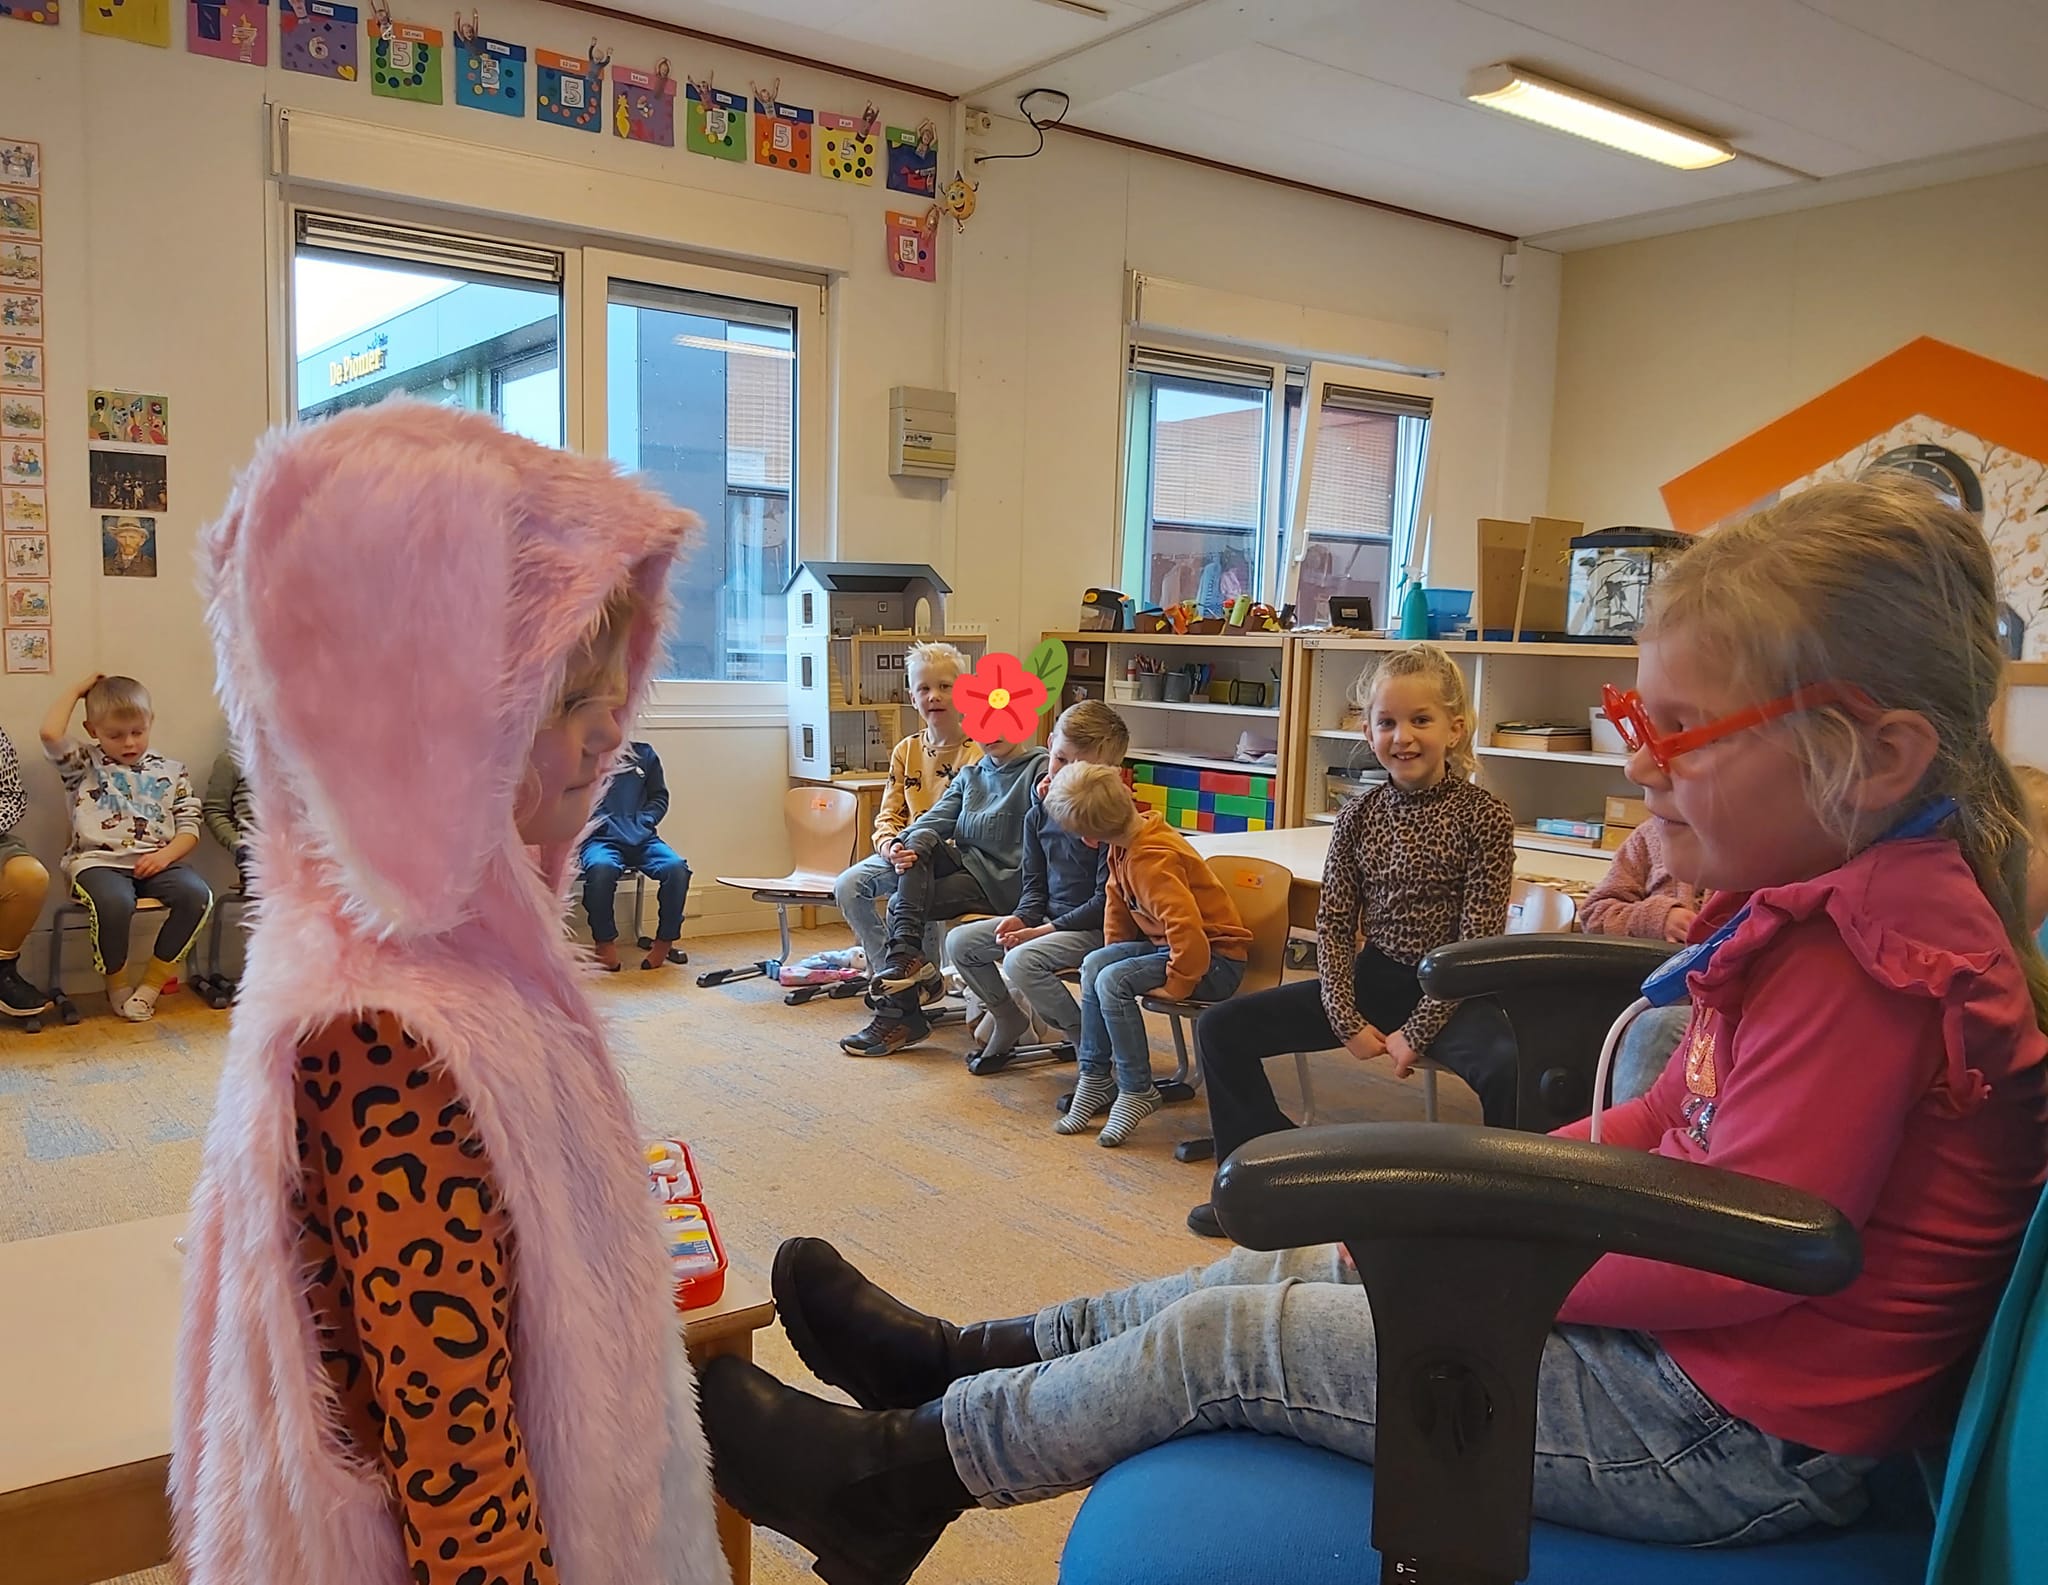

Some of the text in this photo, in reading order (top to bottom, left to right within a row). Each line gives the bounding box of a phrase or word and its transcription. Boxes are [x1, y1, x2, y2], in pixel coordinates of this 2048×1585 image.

[308, 36, 328, 59] 6
[392, 42, 411, 67] 5
[482, 60, 499, 85] 5
[565, 80, 582, 105] 5
[710, 110, 726, 134] 5
[775, 125, 790, 148] 5
[841, 138, 857, 160] 5
[902, 239, 915, 261] 5
[1396, 1562, 1405, 1574] 5
